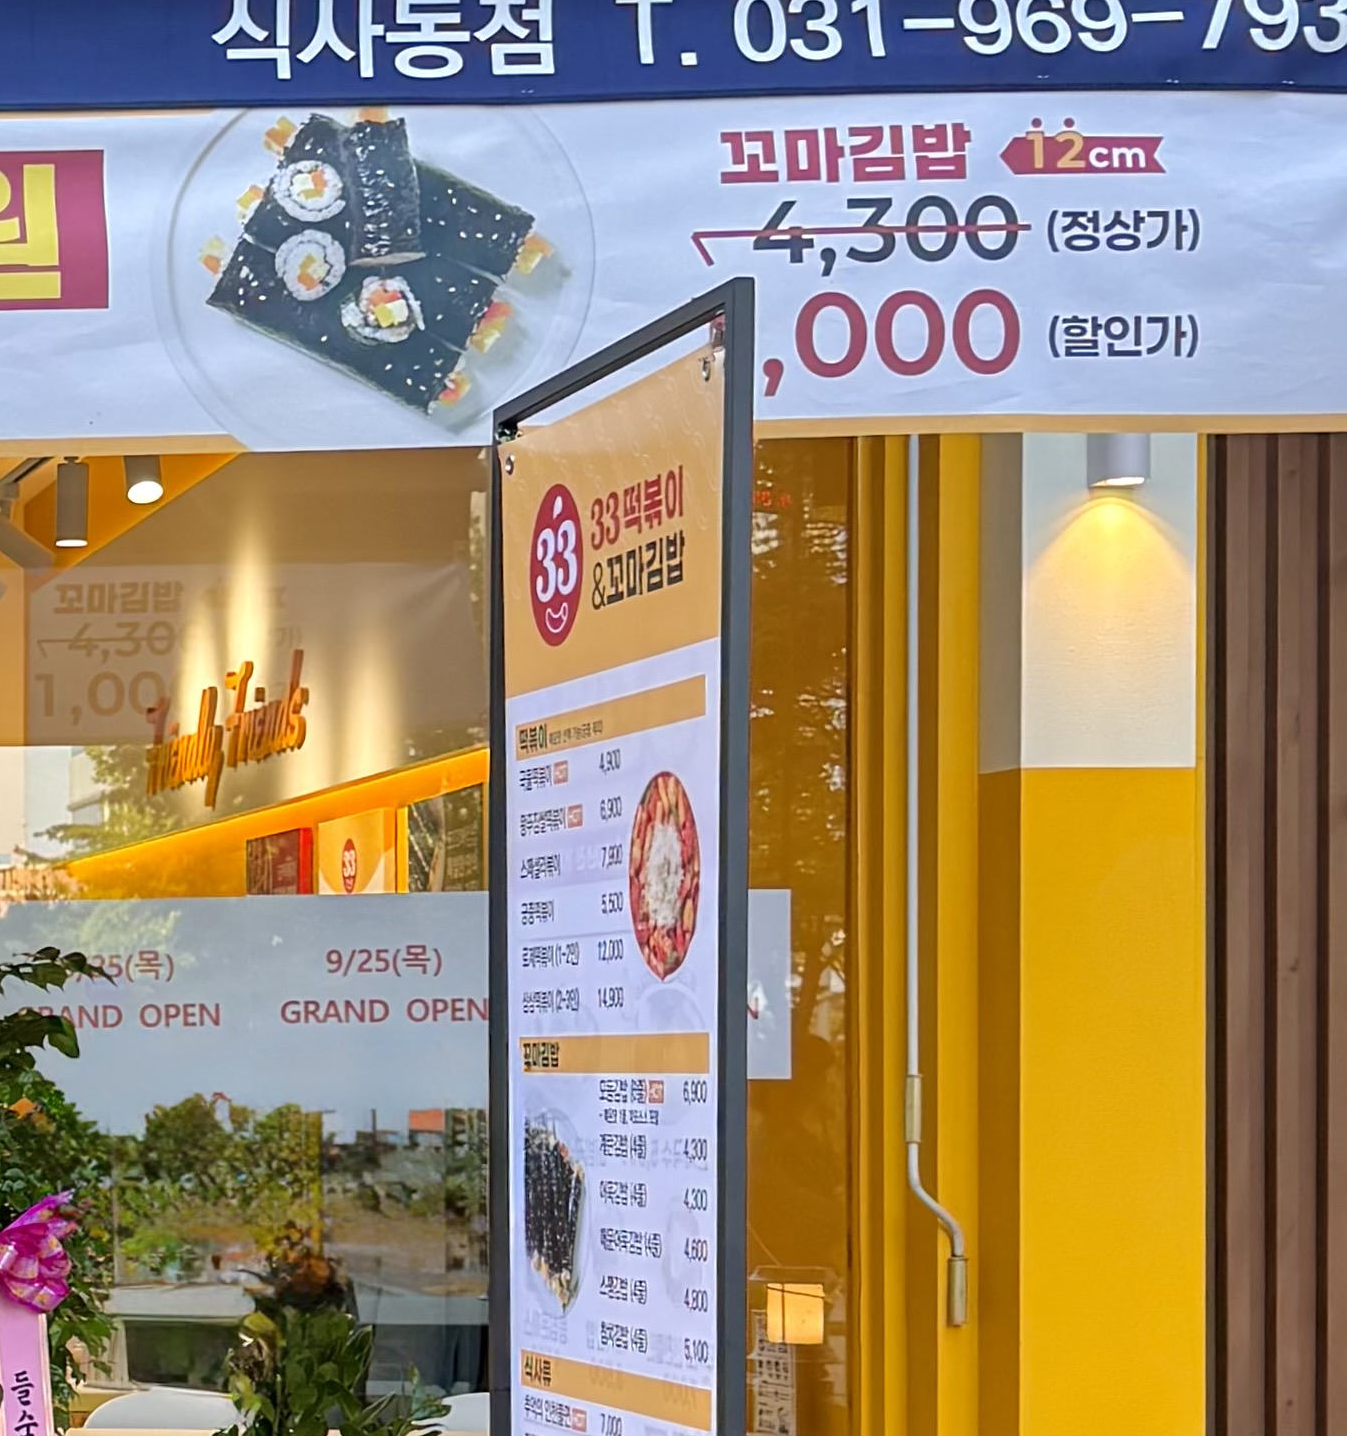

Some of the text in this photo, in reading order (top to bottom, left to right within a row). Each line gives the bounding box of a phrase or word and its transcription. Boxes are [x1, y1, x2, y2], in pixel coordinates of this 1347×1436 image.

[719, 123, 973, 186] 꼬마김밥
[750, 193, 1203, 269] 4,300 (정상가)
[760, 287, 1201, 399] ,000 (할인가)
[590, 464, 685, 551] 33떡볶이
[535, 518, 579, 604] 33
[325, 944, 443, 978] 9/25(목)
[138, 1002, 221, 1029] OPEN
[280, 996, 489, 1025] GRAND OPEN
